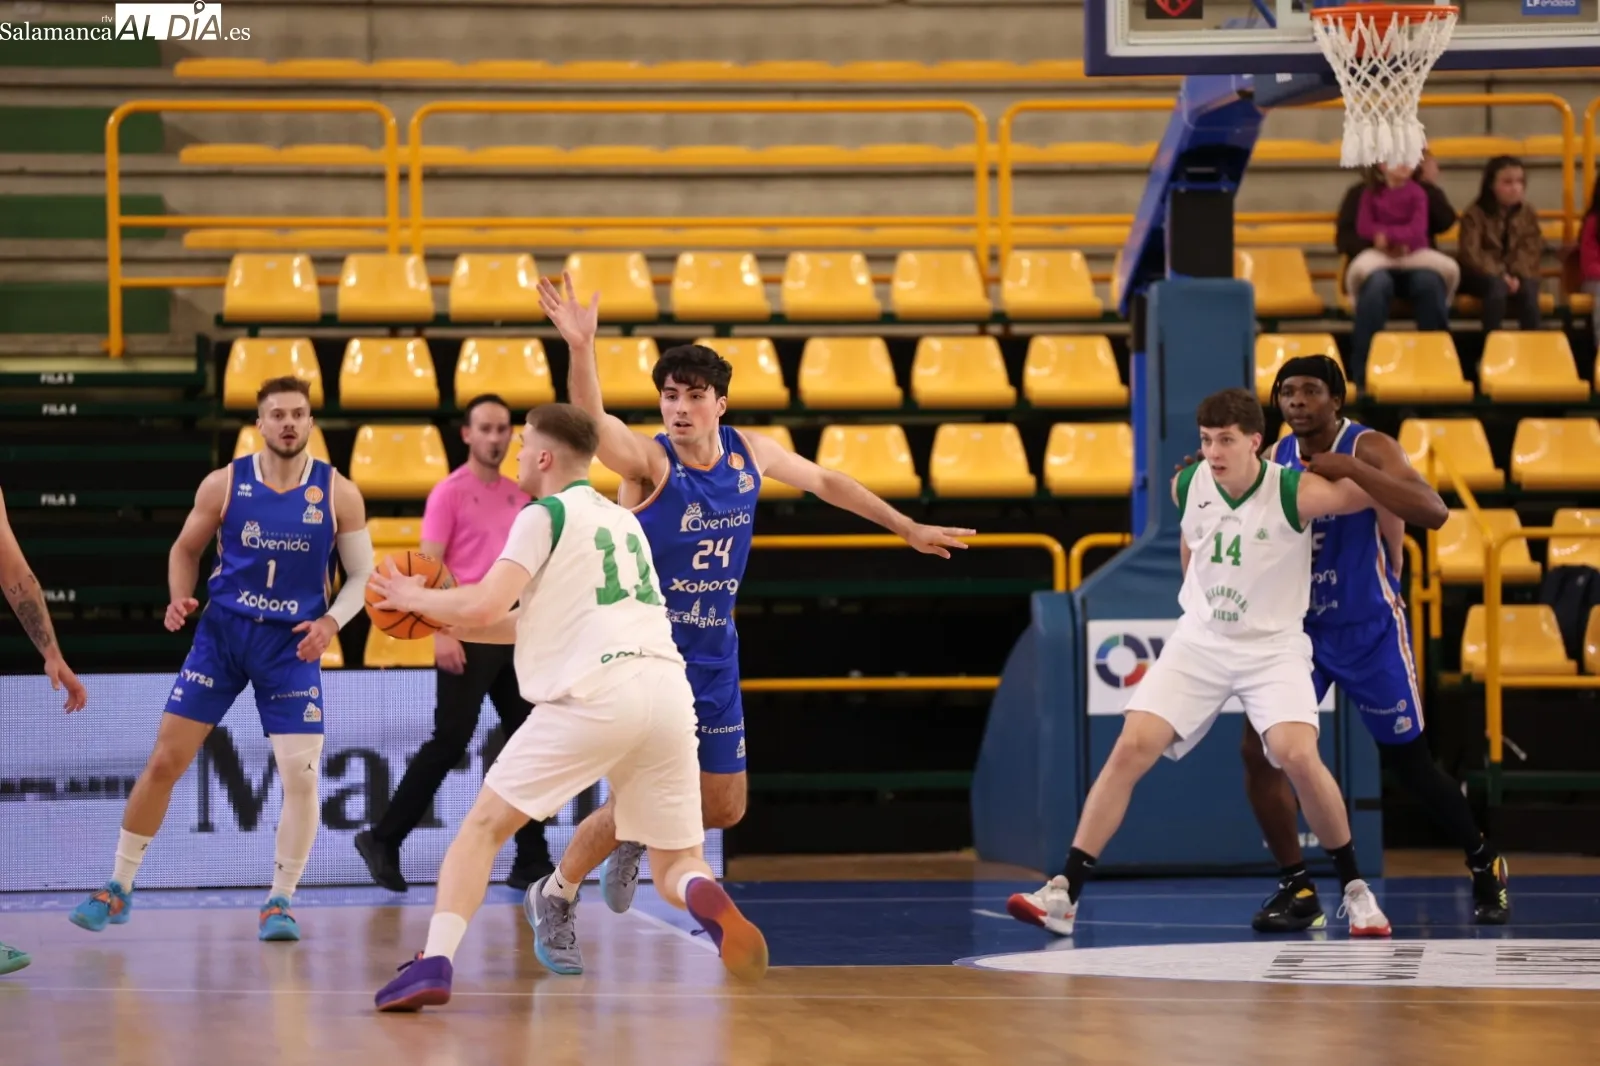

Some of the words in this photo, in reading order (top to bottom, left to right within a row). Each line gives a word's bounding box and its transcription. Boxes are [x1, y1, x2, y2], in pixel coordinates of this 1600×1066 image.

[41, 373, 65, 385] FILA
[42, 403, 67, 415] FILA
[41, 493, 66, 506] FILA
[692, 536, 734, 570] 24
[1211, 532, 1242, 567] 14
[266, 559, 277, 589] 1
[594, 526, 664, 606] 11
[44, 589, 66, 602] ILA
[668, 577, 739, 595] Xoborg
[236, 589, 299, 615] Xoborg
